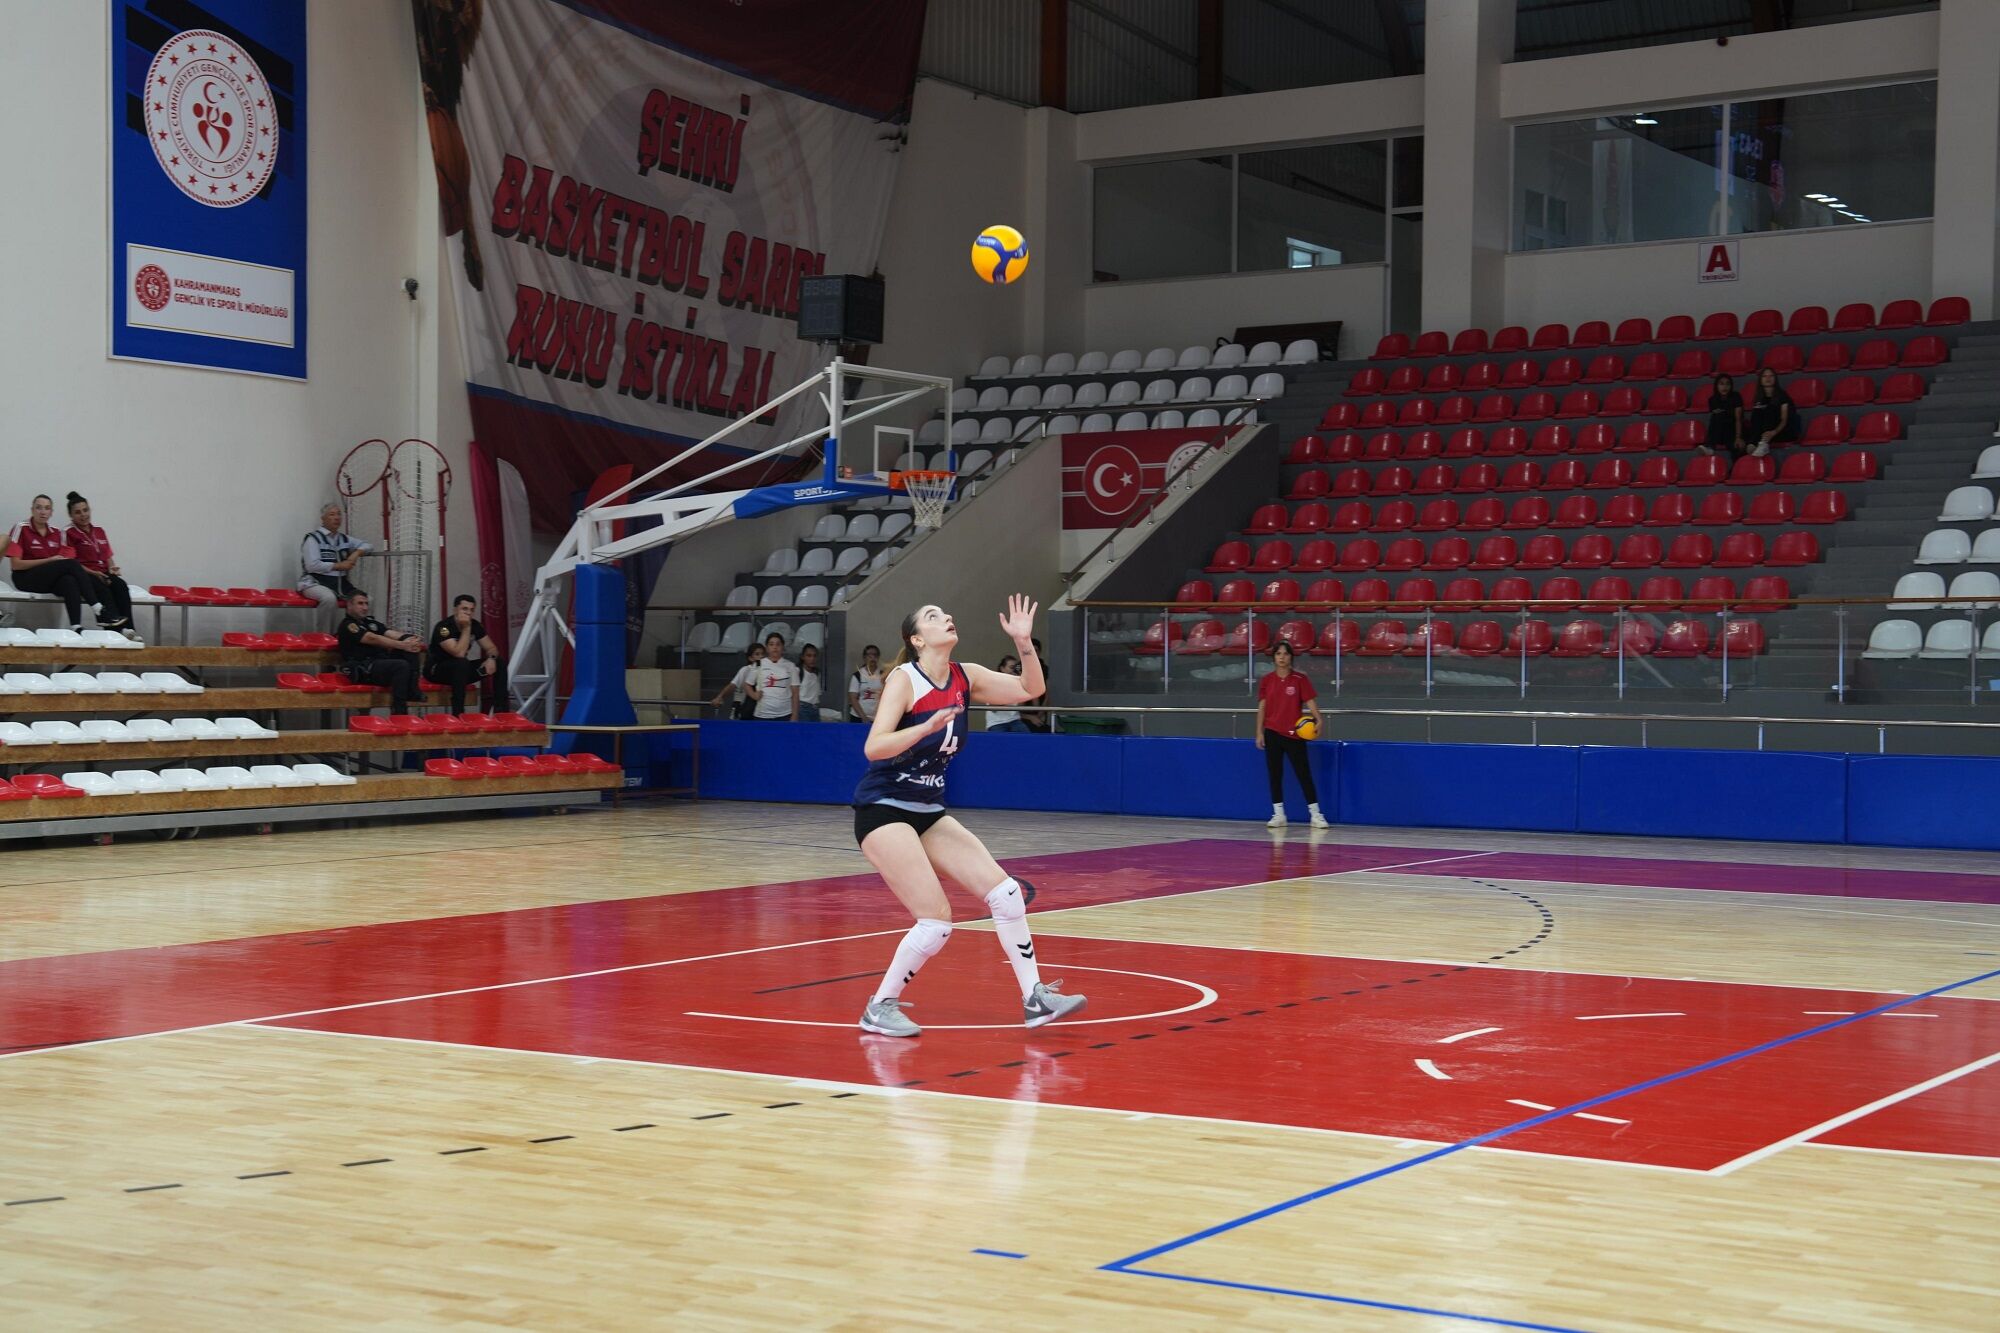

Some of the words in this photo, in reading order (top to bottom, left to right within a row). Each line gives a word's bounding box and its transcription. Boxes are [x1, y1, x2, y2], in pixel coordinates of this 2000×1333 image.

[637, 88, 751, 194] ŞEHRİ
[492, 153, 710, 300] BASKETBOL
[1705, 244, 1732, 272] A
[174, 291, 205, 308] GENÇLİK
[206, 297, 216, 308] VE
[217, 298, 236, 311] SPOR
[507, 283, 618, 389] RUHU
[617, 291, 780, 426] İSTİKLAL
[939, 719, 959, 756] 4
